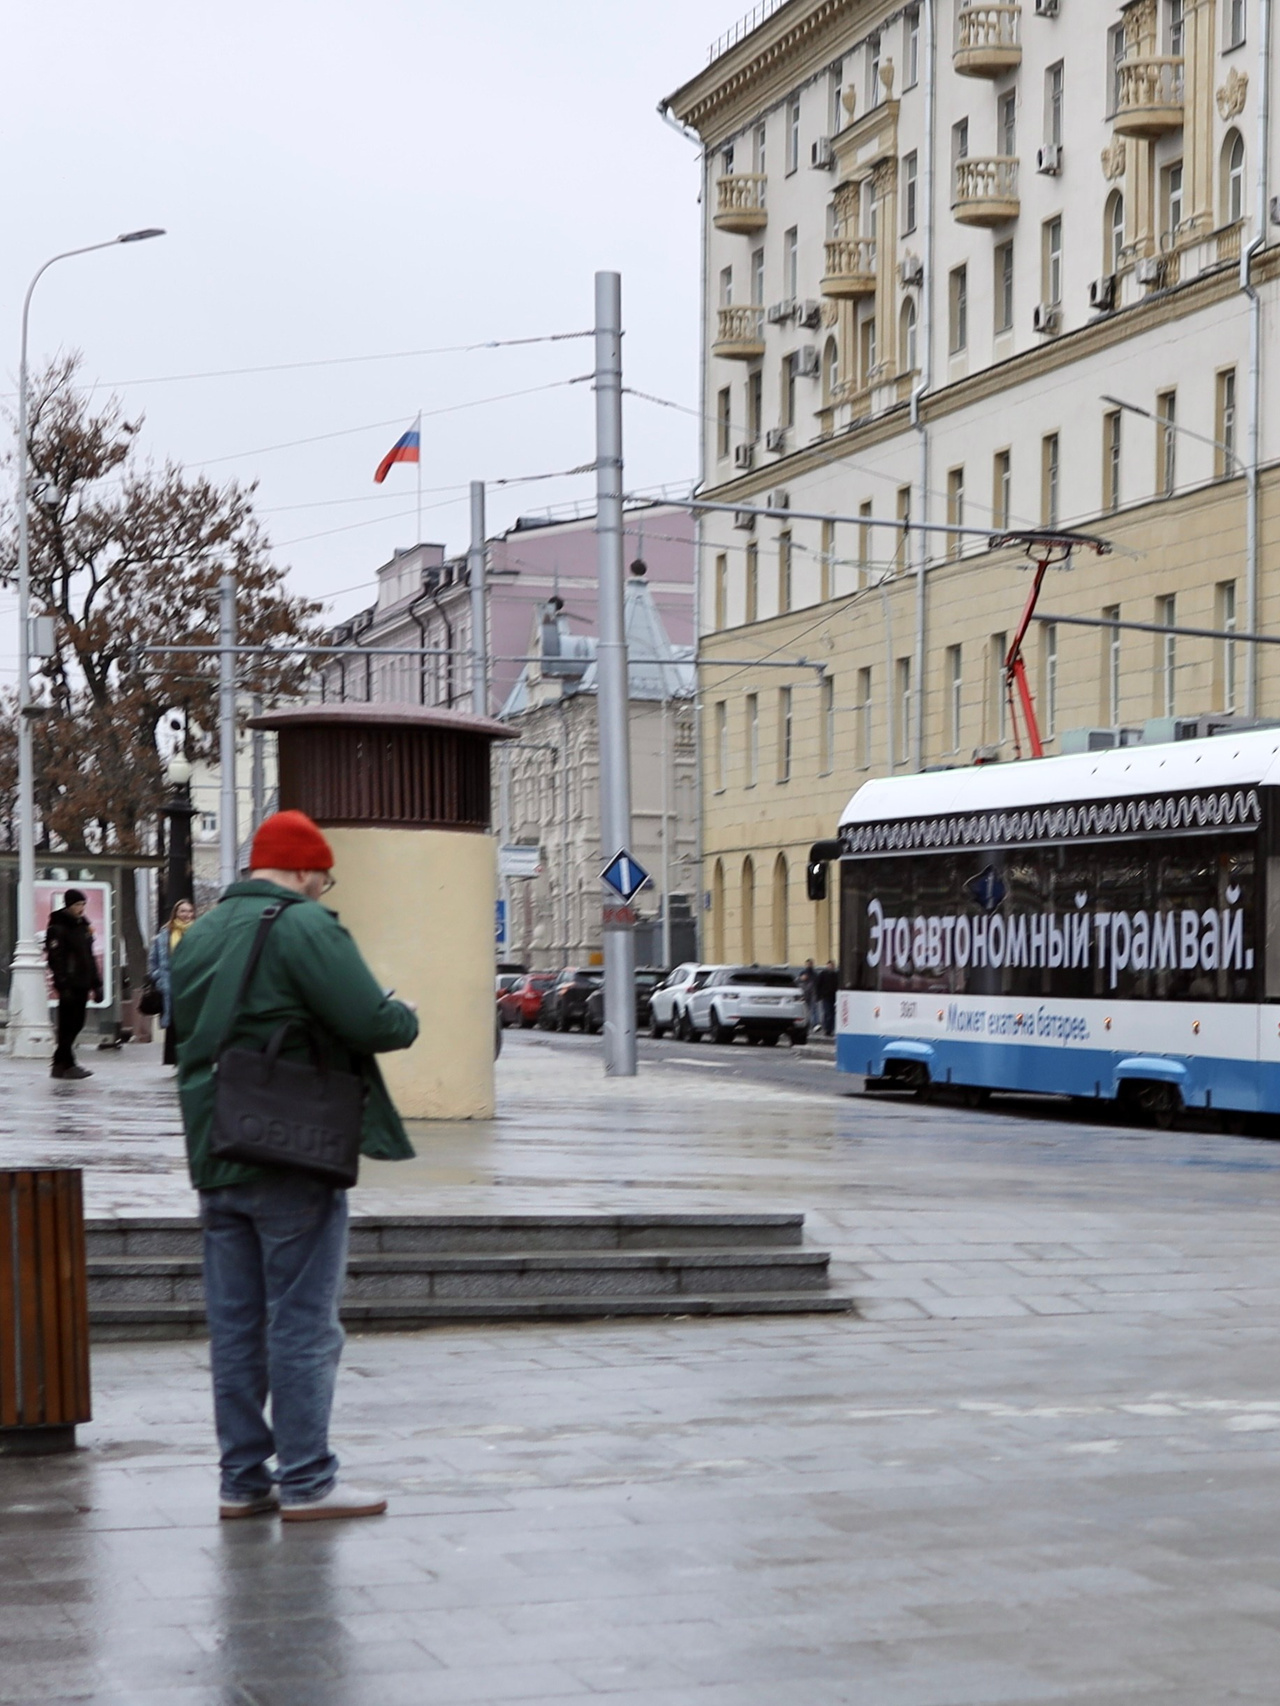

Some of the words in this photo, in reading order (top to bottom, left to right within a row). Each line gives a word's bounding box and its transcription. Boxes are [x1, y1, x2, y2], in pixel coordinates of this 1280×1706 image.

[867, 897, 911, 968] Это
[912, 889, 1091, 970] автономный
[1095, 884, 1255, 990] трамвай.
[946, 1002, 986, 1032] Может
[1037, 1005, 1091, 1047] батарее.
